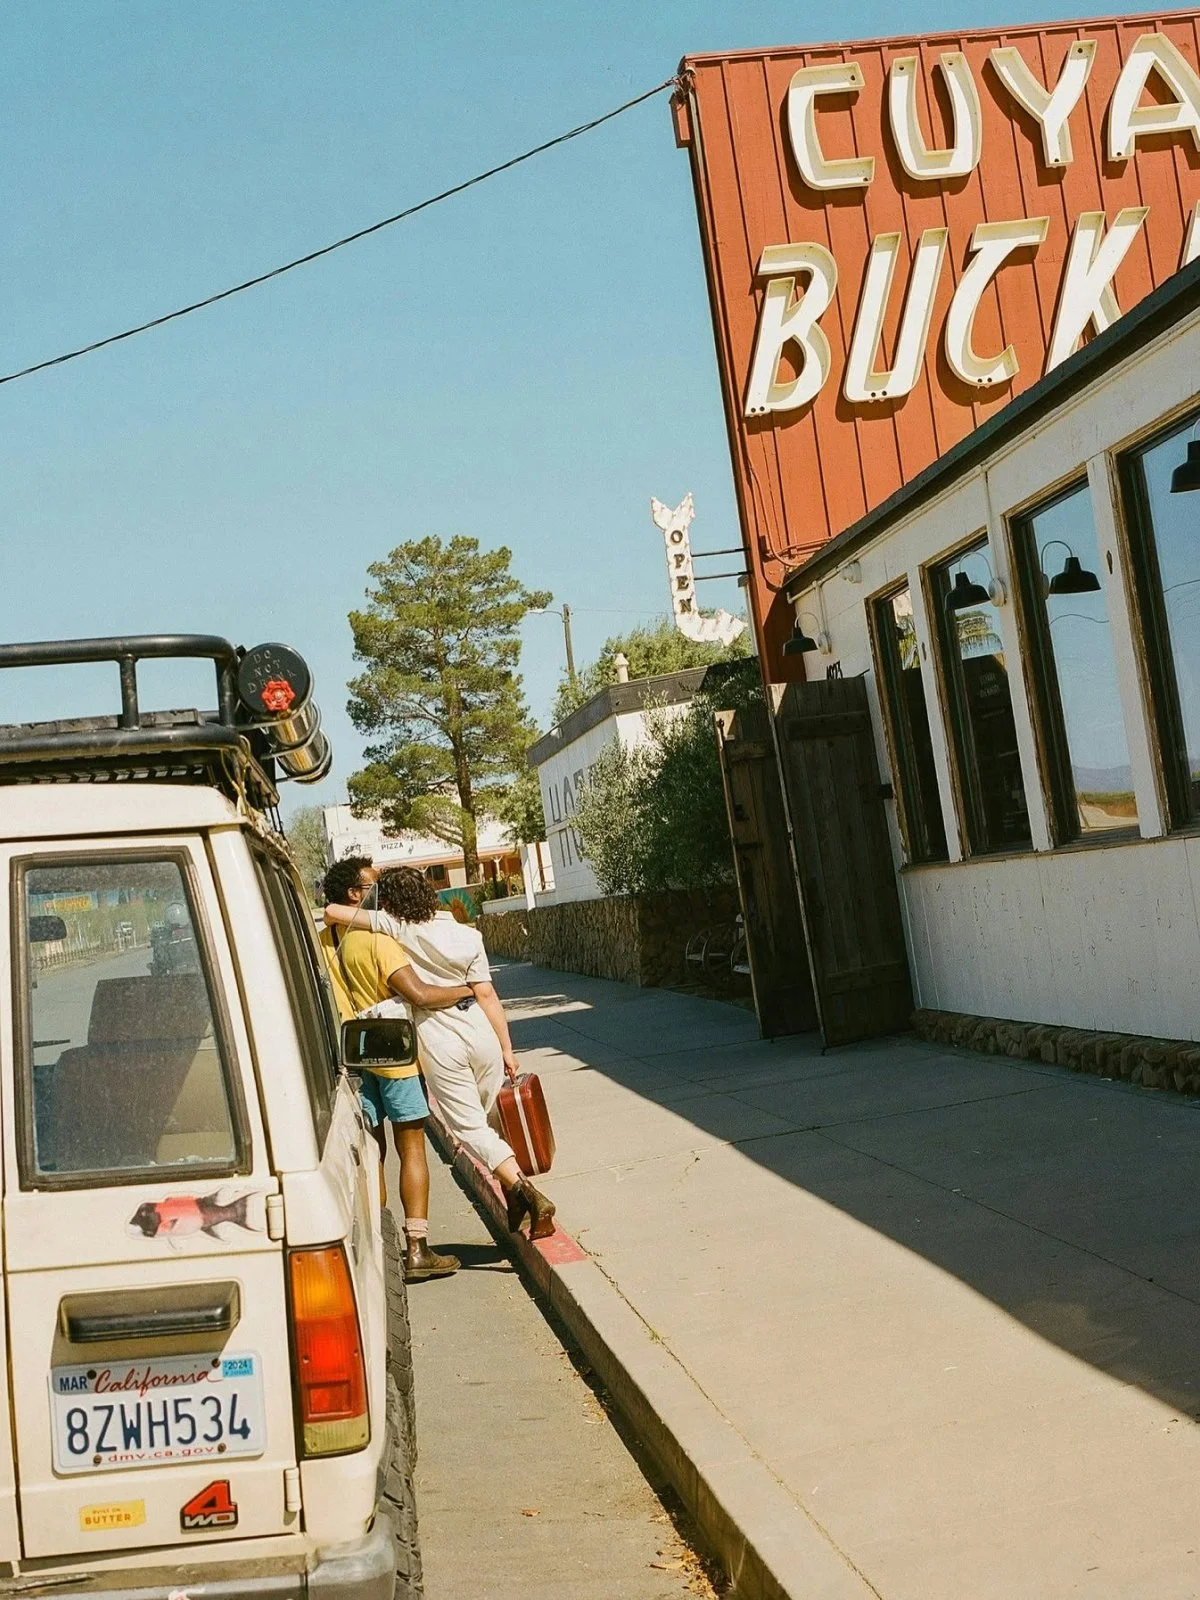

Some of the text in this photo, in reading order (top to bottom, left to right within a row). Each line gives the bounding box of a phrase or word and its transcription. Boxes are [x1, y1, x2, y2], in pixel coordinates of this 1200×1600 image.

[788, 32, 1200, 191] CUYA
[744, 201, 1200, 418] BUCK
[670, 529, 693, 613] OPEN
[252, 649, 272, 664] DO
[253, 659, 281, 677] NOT
[381, 842, 404, 850] PIZZA
[227, 1360, 248, 1370] 2024
[59, 1376, 88, 1392] MAR
[94, 1367, 222, 1397] California
[66, 1393, 251, 1456] 8ZWH534
[107, 1446, 215, 1463] dmv.ca.gov
[84, 1513, 132, 1525] BUTTER
